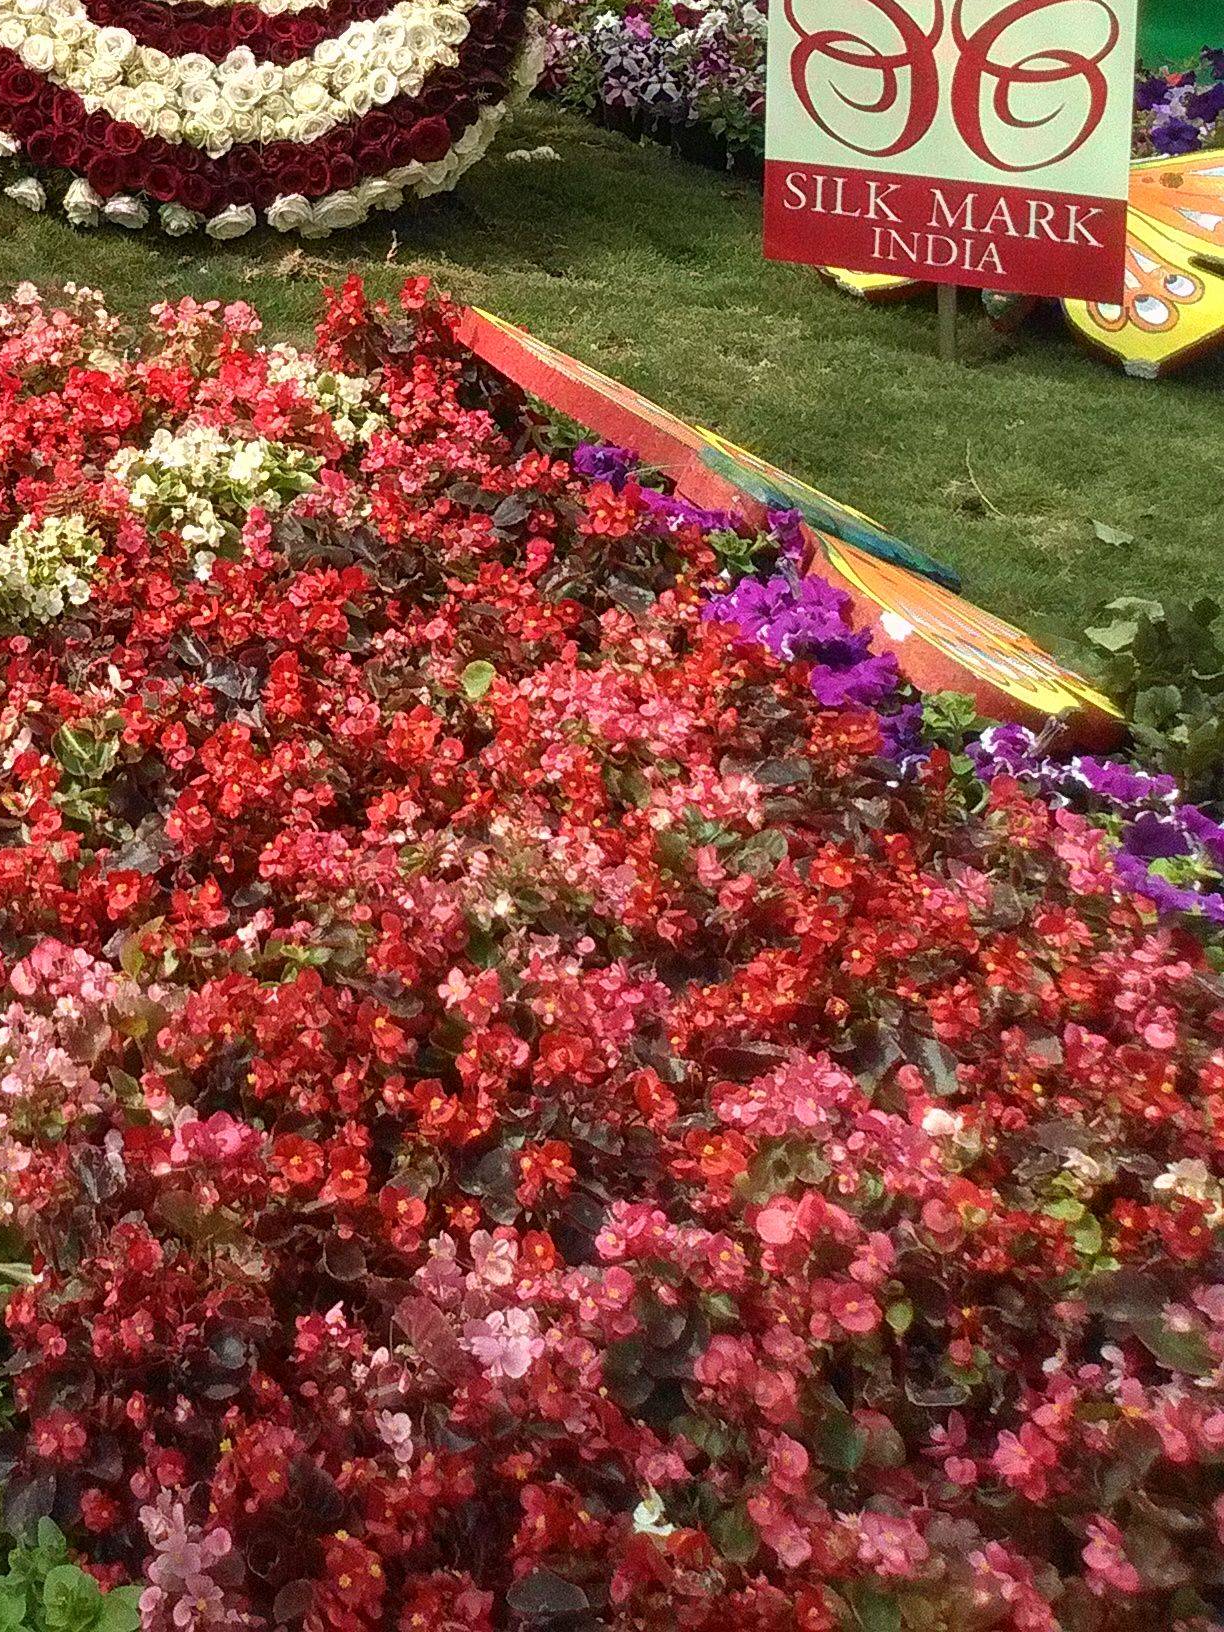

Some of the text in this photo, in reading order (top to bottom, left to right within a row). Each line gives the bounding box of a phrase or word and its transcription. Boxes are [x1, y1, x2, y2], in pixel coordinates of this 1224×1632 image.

[783, 172, 1104, 248] SILK MARK
[871, 227, 1007, 275] INDIA
